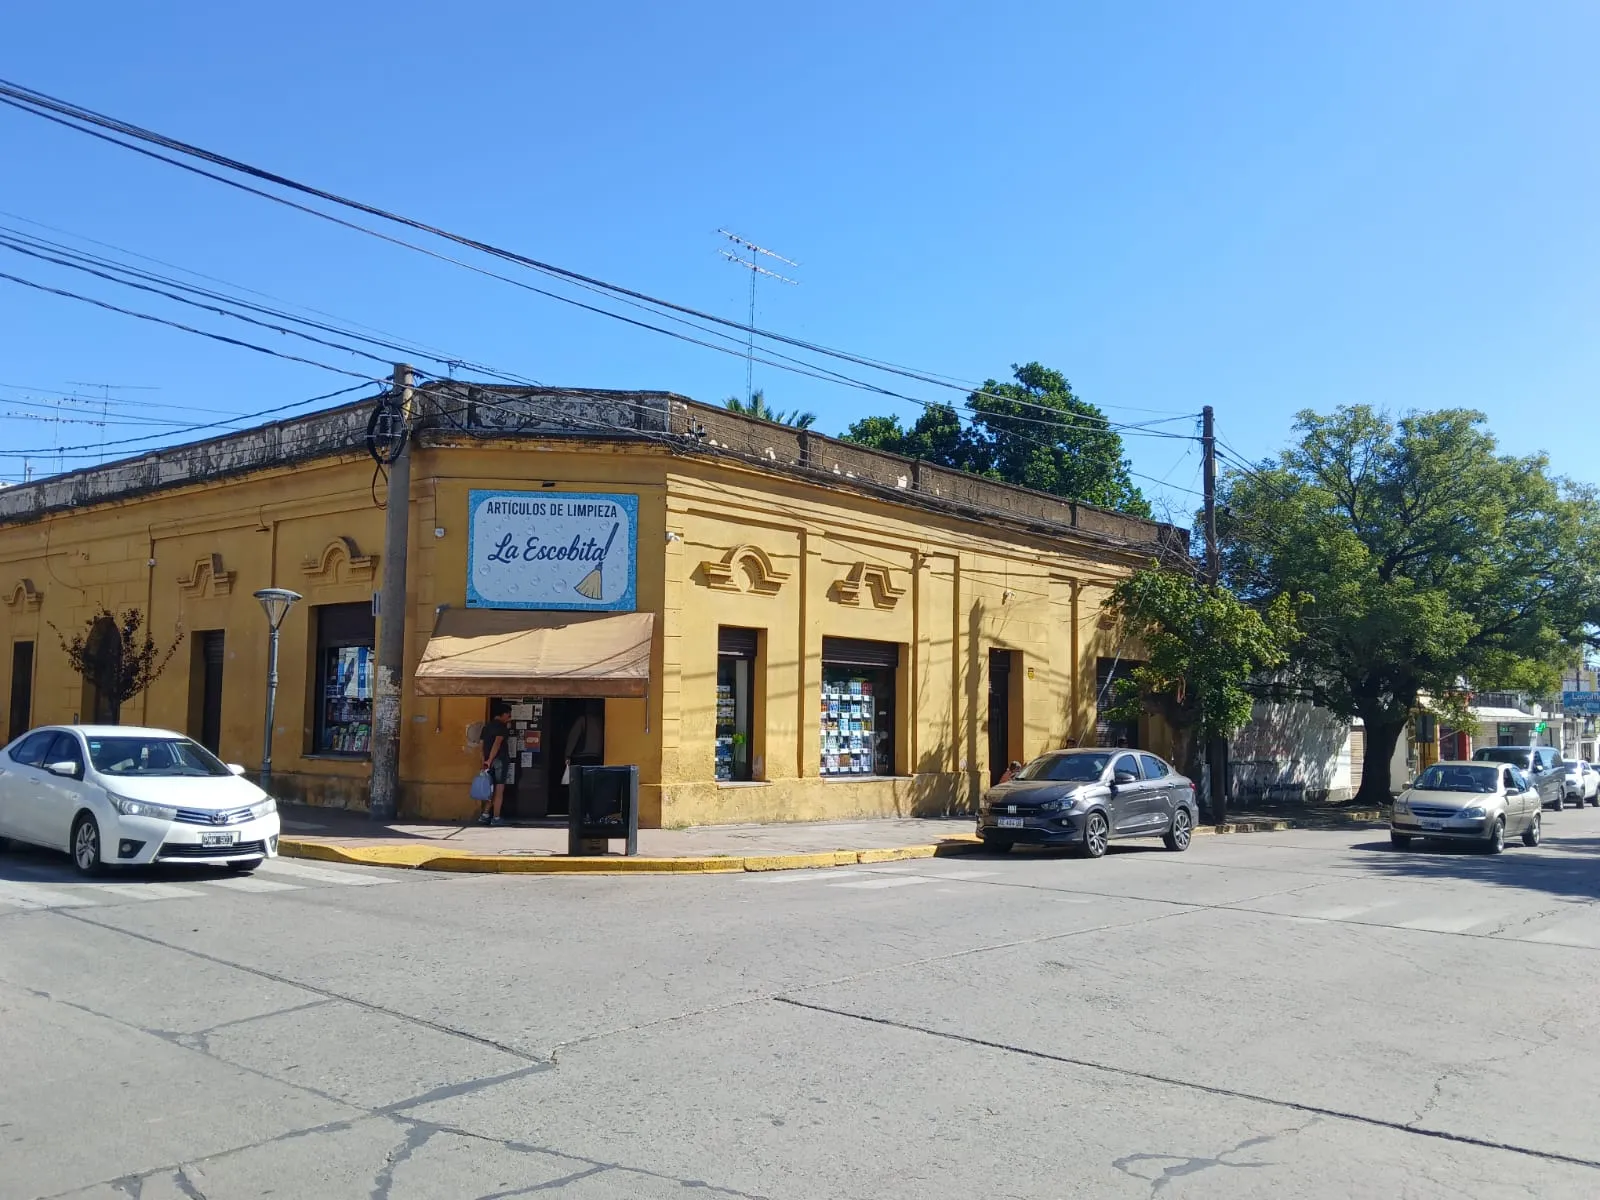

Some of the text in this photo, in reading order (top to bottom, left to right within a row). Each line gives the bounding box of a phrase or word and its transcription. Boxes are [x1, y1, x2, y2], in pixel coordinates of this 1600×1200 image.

[550, 503, 563, 516] DE
[567, 503, 617, 518] LIMPIEZA
[488, 532, 519, 563] La
